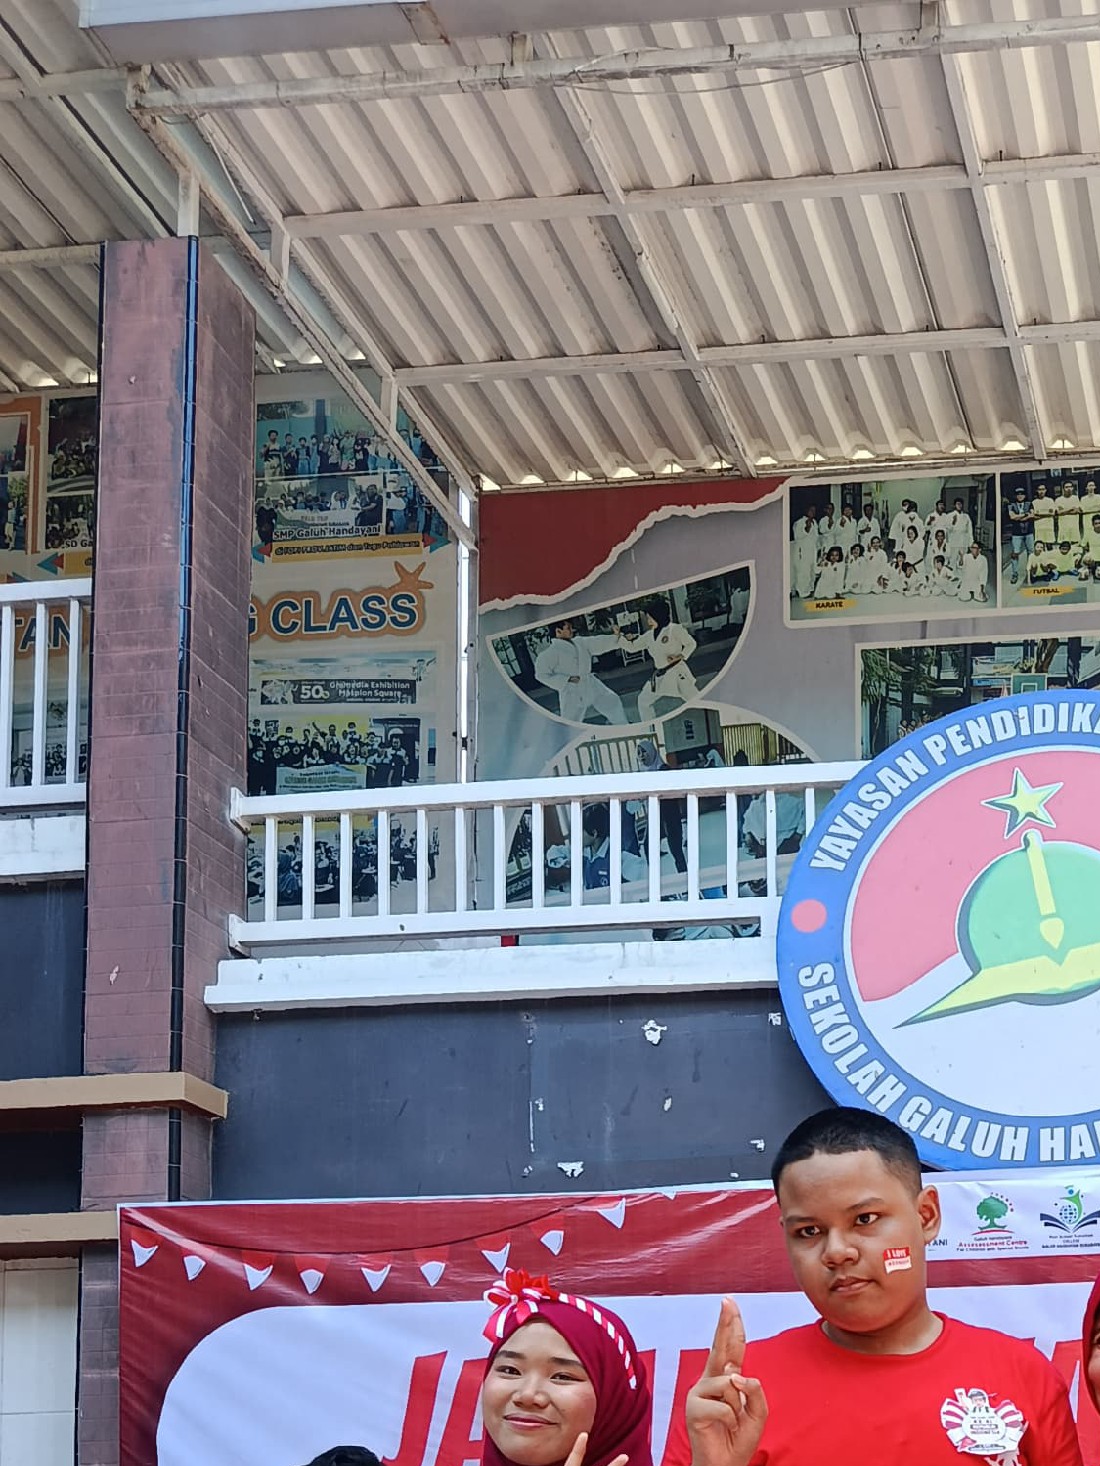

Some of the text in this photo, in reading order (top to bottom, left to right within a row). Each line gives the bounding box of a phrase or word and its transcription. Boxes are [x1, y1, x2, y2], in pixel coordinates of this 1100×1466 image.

[273, 530, 294, 539] SMP
[296, 527, 326, 538] Galuh
[271, 593, 418, 634] CLASS
[815, 601, 843, 609] KARATE
[809, 748, 929, 874] YAYASAN
[797, 961, 907, 1123] SEKOLAH
[899, 1094, 1027, 1162] GALUH
